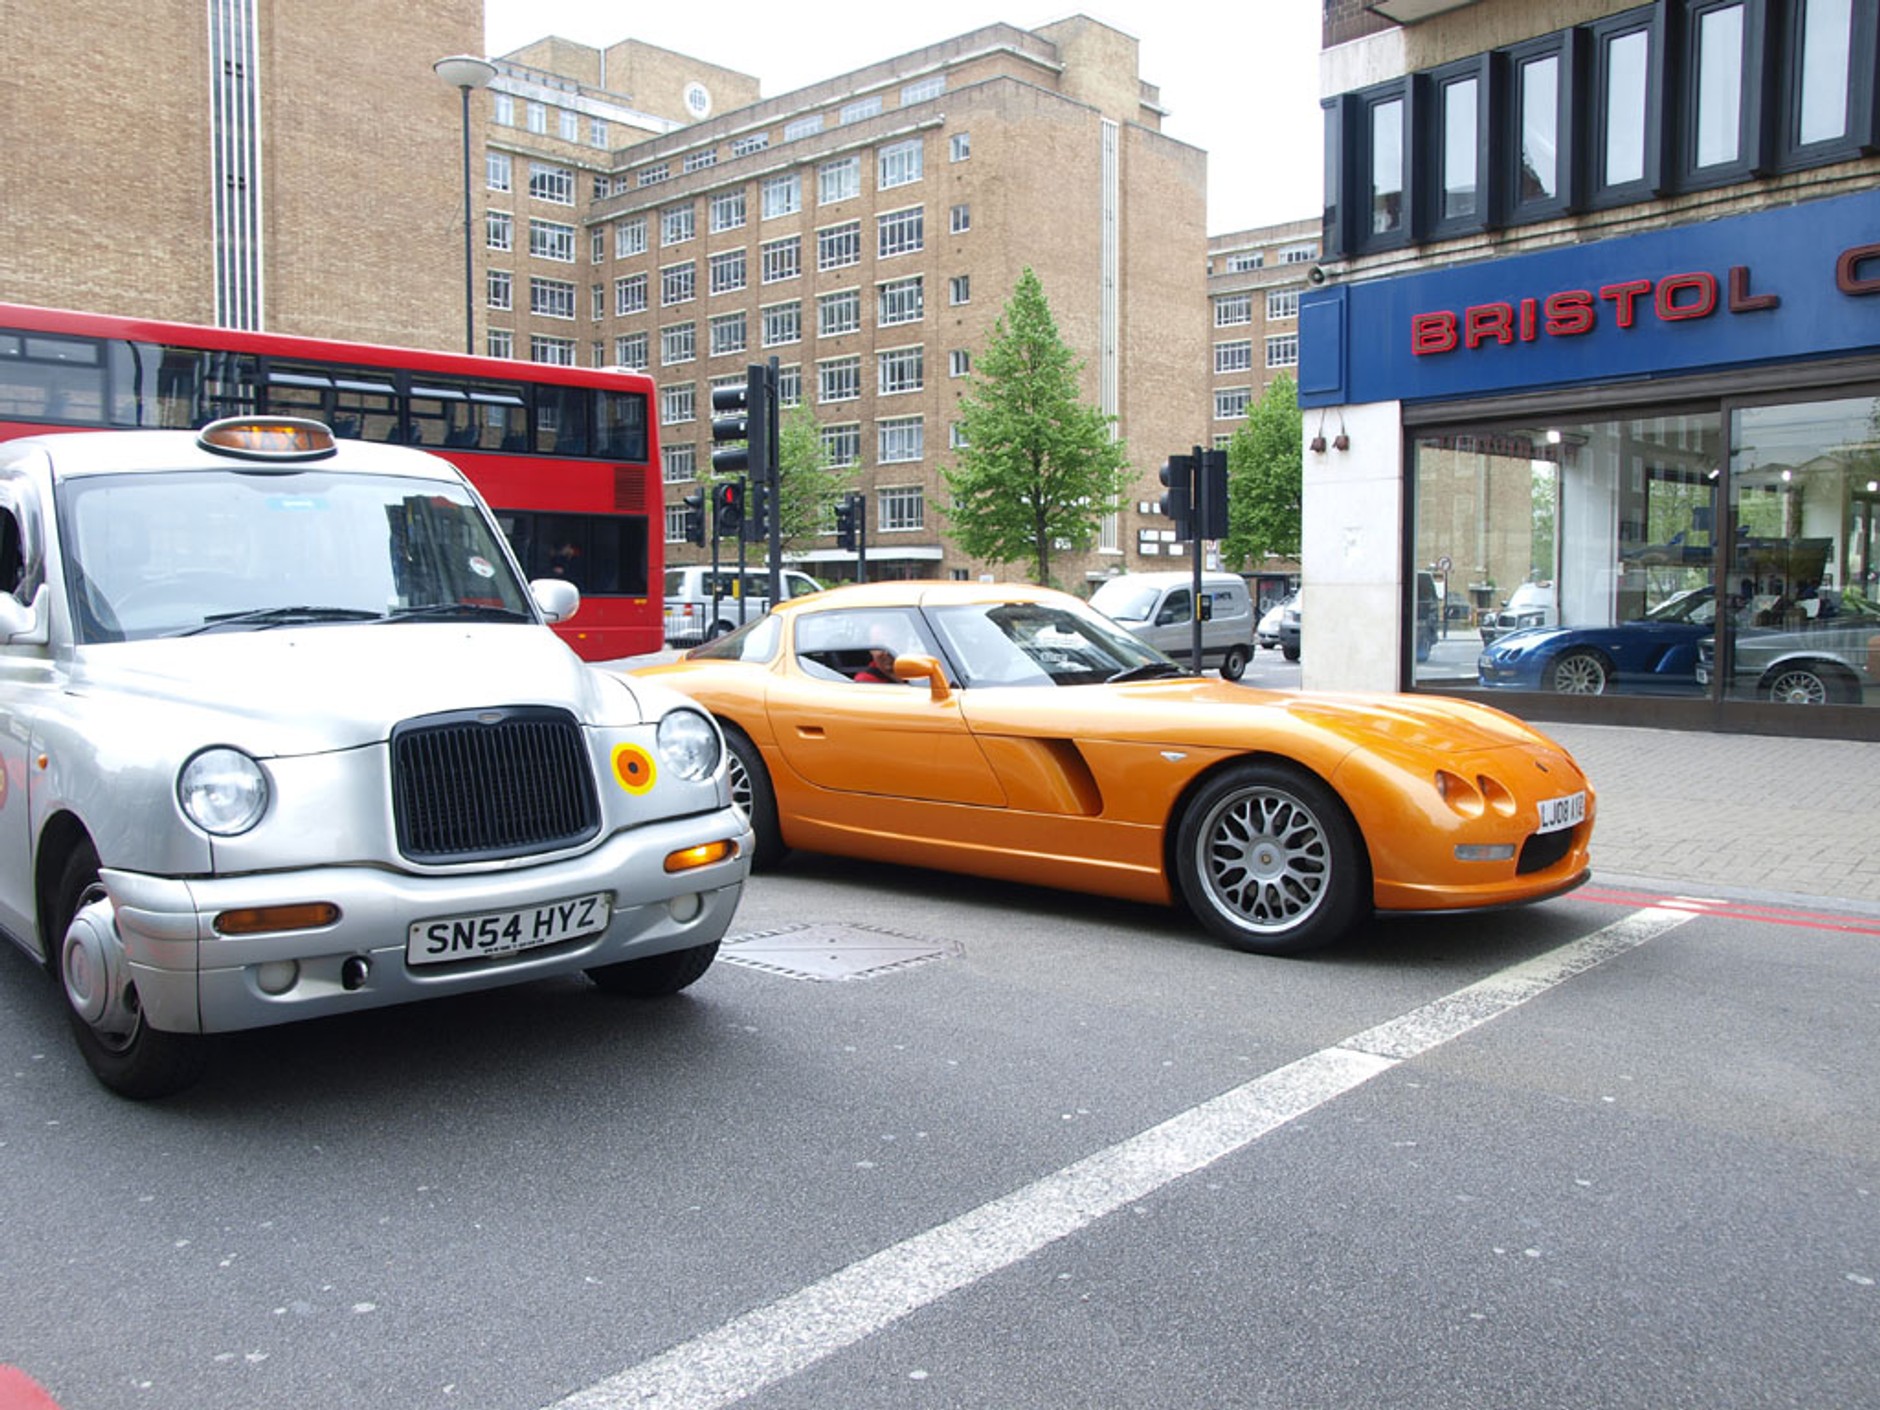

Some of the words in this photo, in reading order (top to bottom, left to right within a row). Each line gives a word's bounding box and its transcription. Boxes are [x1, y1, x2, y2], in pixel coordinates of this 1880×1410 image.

[1411, 265, 1778, 356] BRISTOL
[241, 427, 314, 451] TAXI
[426, 914, 522, 954] SN54
[533, 897, 598, 939] HYZ
